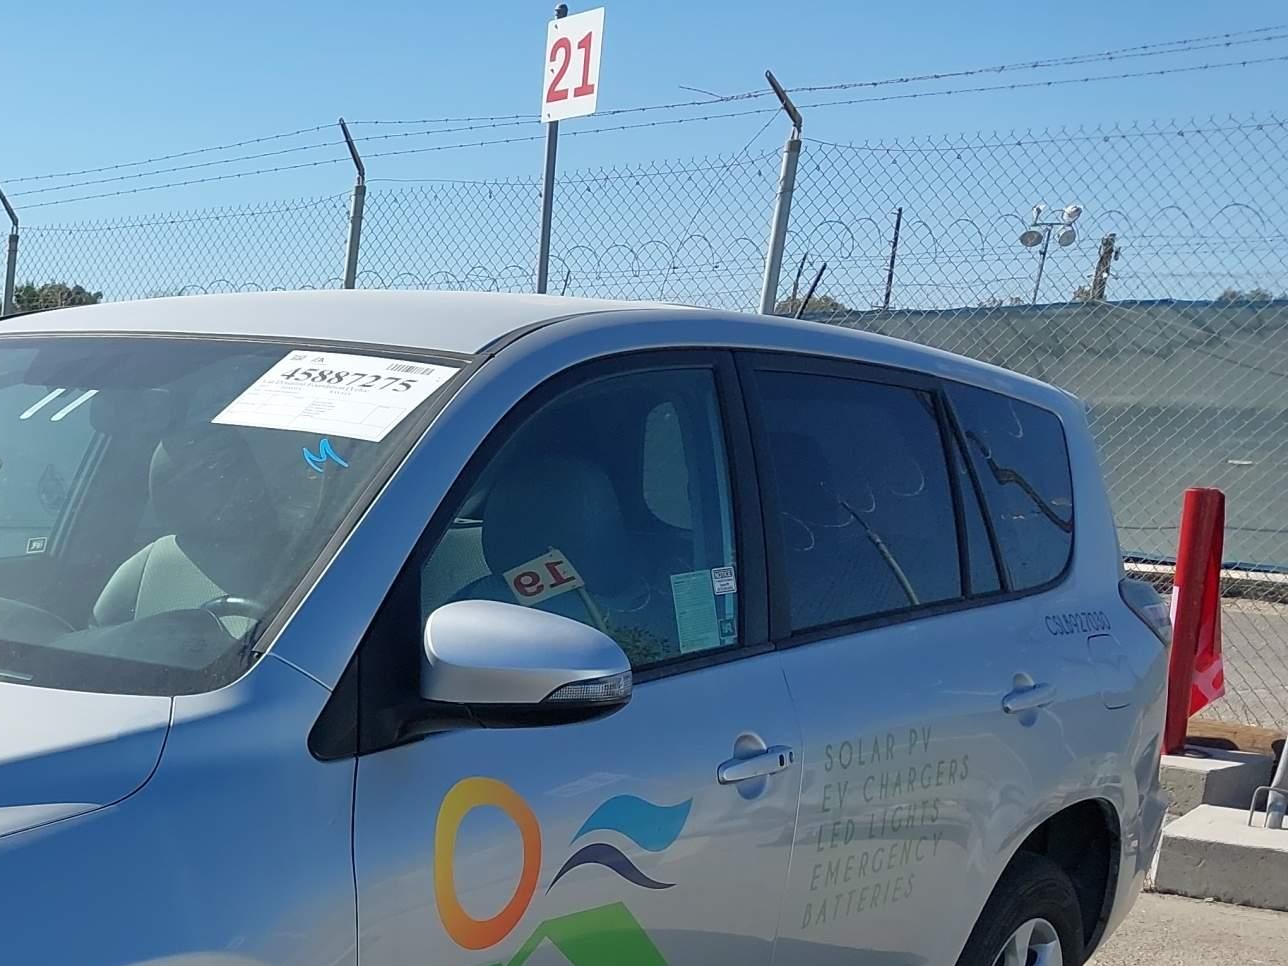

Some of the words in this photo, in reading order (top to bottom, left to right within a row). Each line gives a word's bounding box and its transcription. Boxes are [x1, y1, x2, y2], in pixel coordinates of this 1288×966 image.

[545, 30, 596, 104] 21
[281, 367, 419, 393] 45887275
[302, 437, 350, 473] M
[824, 732, 895, 772] SOLAR
[908, 725, 932, 756] PV
[821, 780, 849, 814] EV
[863, 754, 970, 803] CHARGERS
[816, 818, 856, 853] LED
[868, 797, 940, 840] LIGHTS
[809, 831, 944, 892] EMERGENCY
[801, 872, 916, 930] BATTERIES
